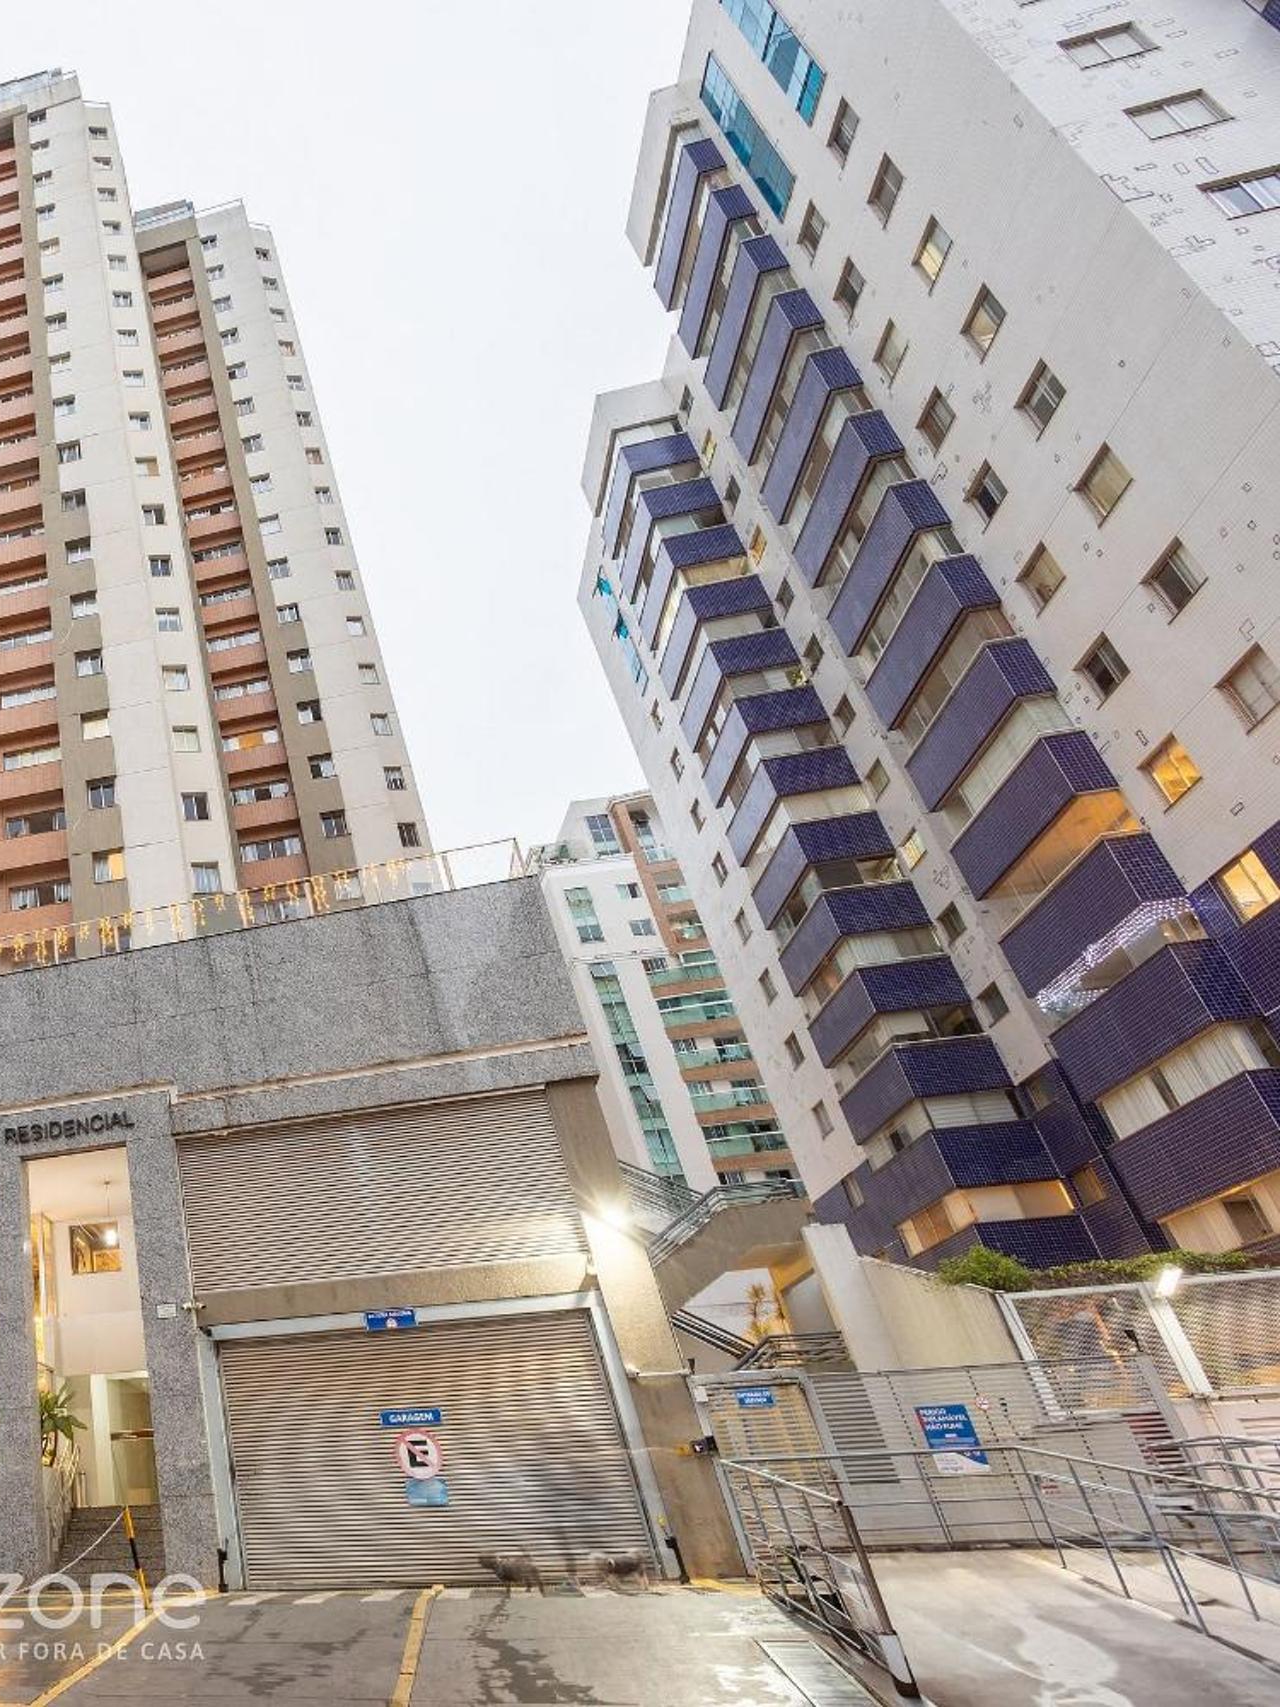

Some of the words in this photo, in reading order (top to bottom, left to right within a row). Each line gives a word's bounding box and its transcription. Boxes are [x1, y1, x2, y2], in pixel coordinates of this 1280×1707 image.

[4, 1110, 135, 1145] RESIDENCIAL
[389, 1413, 434, 1423] GARAGEM
[407, 1440, 429, 1468] E
